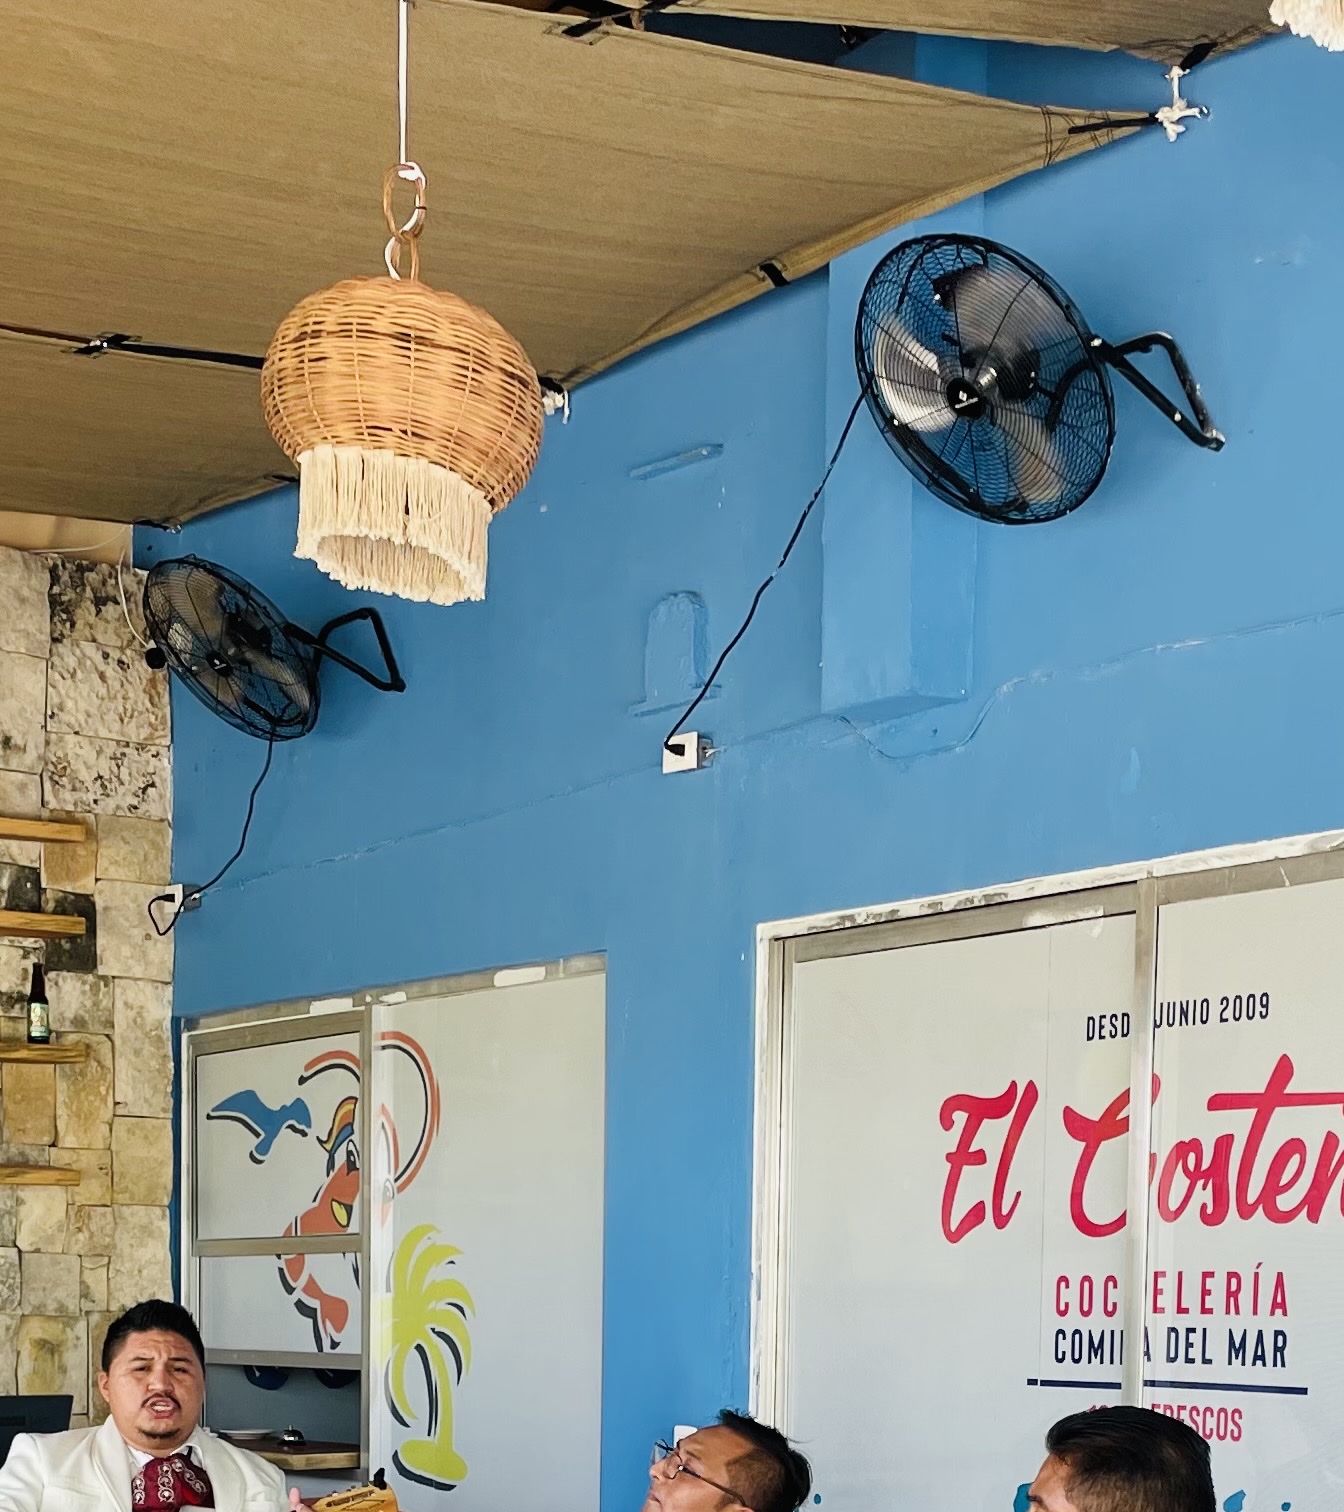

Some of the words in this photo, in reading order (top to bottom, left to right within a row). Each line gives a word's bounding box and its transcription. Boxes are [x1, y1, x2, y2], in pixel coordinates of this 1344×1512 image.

[1086, 1012, 1131, 1042] DESD
[1153, 998, 1210, 1029] JUNIO
[1219, 991, 1270, 1024] 2009
[939, 1079, 1039, 1244] El
[1056, 1261, 1288, 1318] COCELERÍA
[1054, 1327, 1152, 1365] COMIA
[1166, 1327, 1213, 1365] DEL
[1227, 1328, 1288, 1368] MAR
[1151, 1402, 1243, 1442] ESCOS
